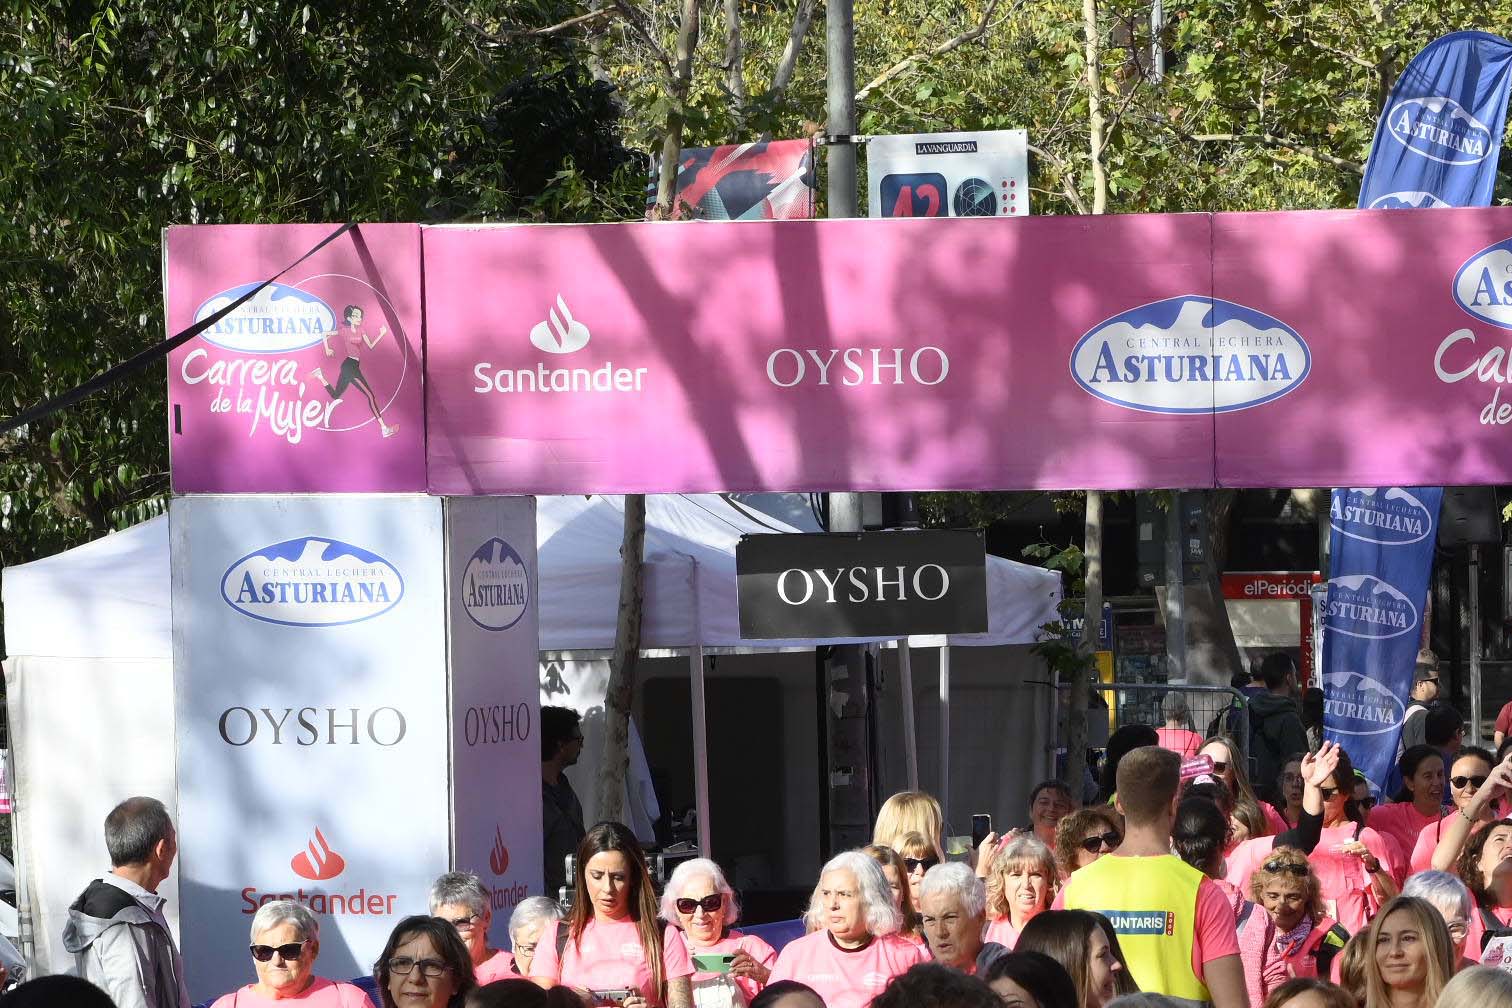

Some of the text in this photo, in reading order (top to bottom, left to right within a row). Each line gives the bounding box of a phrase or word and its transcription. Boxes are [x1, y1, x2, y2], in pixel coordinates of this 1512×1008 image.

[1394, 110, 1484, 157] ASTURIANA
[206, 307, 324, 335] ASTURIANA
[1125, 336, 1285, 349] CENTRAL LECHERA
[181, 348, 299, 385] Carrera
[472, 361, 649, 395] Santander
[765, 346, 950, 388] OYSHO
[1089, 340, 1293, 384] ASTURIANA
[209, 382, 344, 445] de la Mujer
[1330, 495, 1423, 536] ASTURIANA
[235, 571, 391, 605] ASTURIANA
[263, 568, 385, 578] CENTRAL LECHERA
[777, 563, 950, 606] OYSHO
[467, 577, 525, 608] ASTURIANA
[1326, 602, 1408, 629] STURIANA
[218, 705, 408, 748] OYSHO
[464, 702, 531, 747] OYSHO
[1324, 699, 1396, 725] TURIANA
